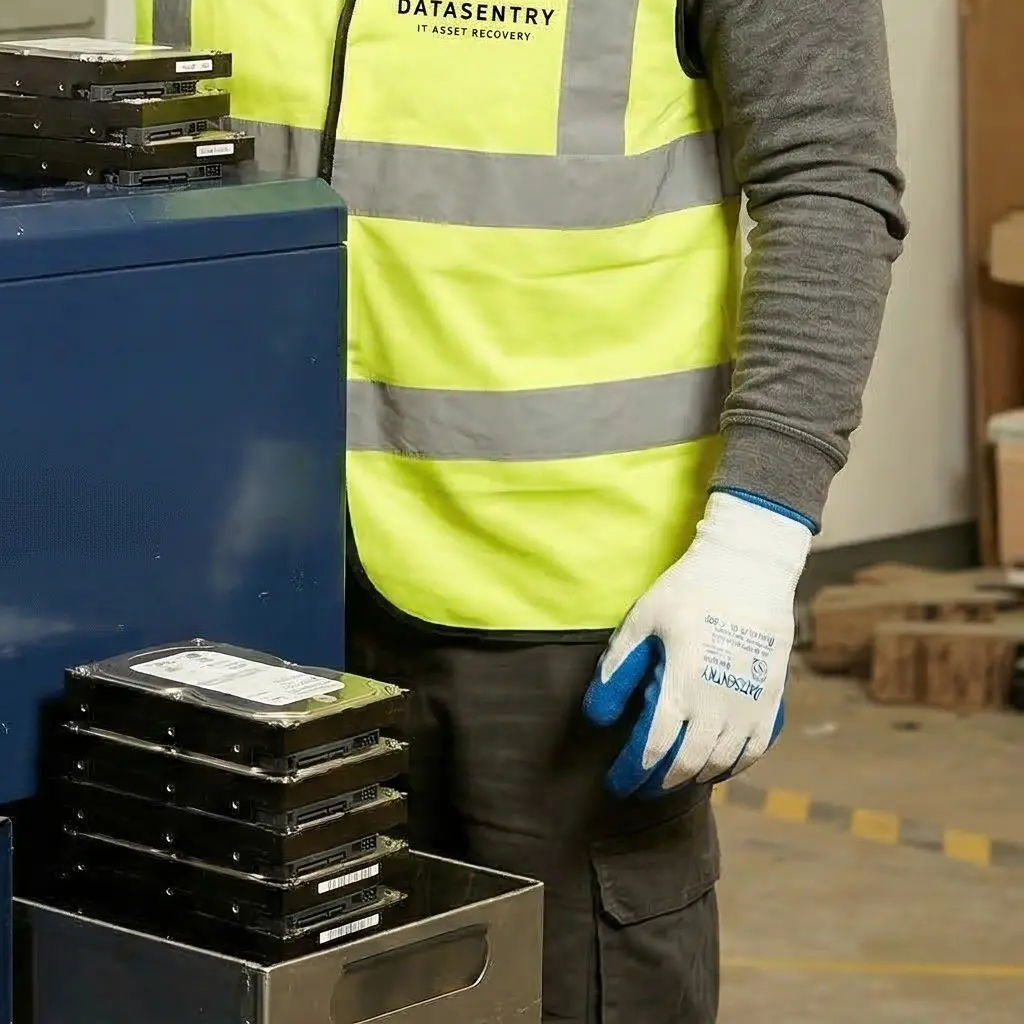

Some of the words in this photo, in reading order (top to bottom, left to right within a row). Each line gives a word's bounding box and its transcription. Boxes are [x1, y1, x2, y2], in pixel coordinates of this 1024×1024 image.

[417, 24, 428, 33] IT
[432, 25, 468, 36] ASSET
[472, 29, 531, 41] RECOVERY
